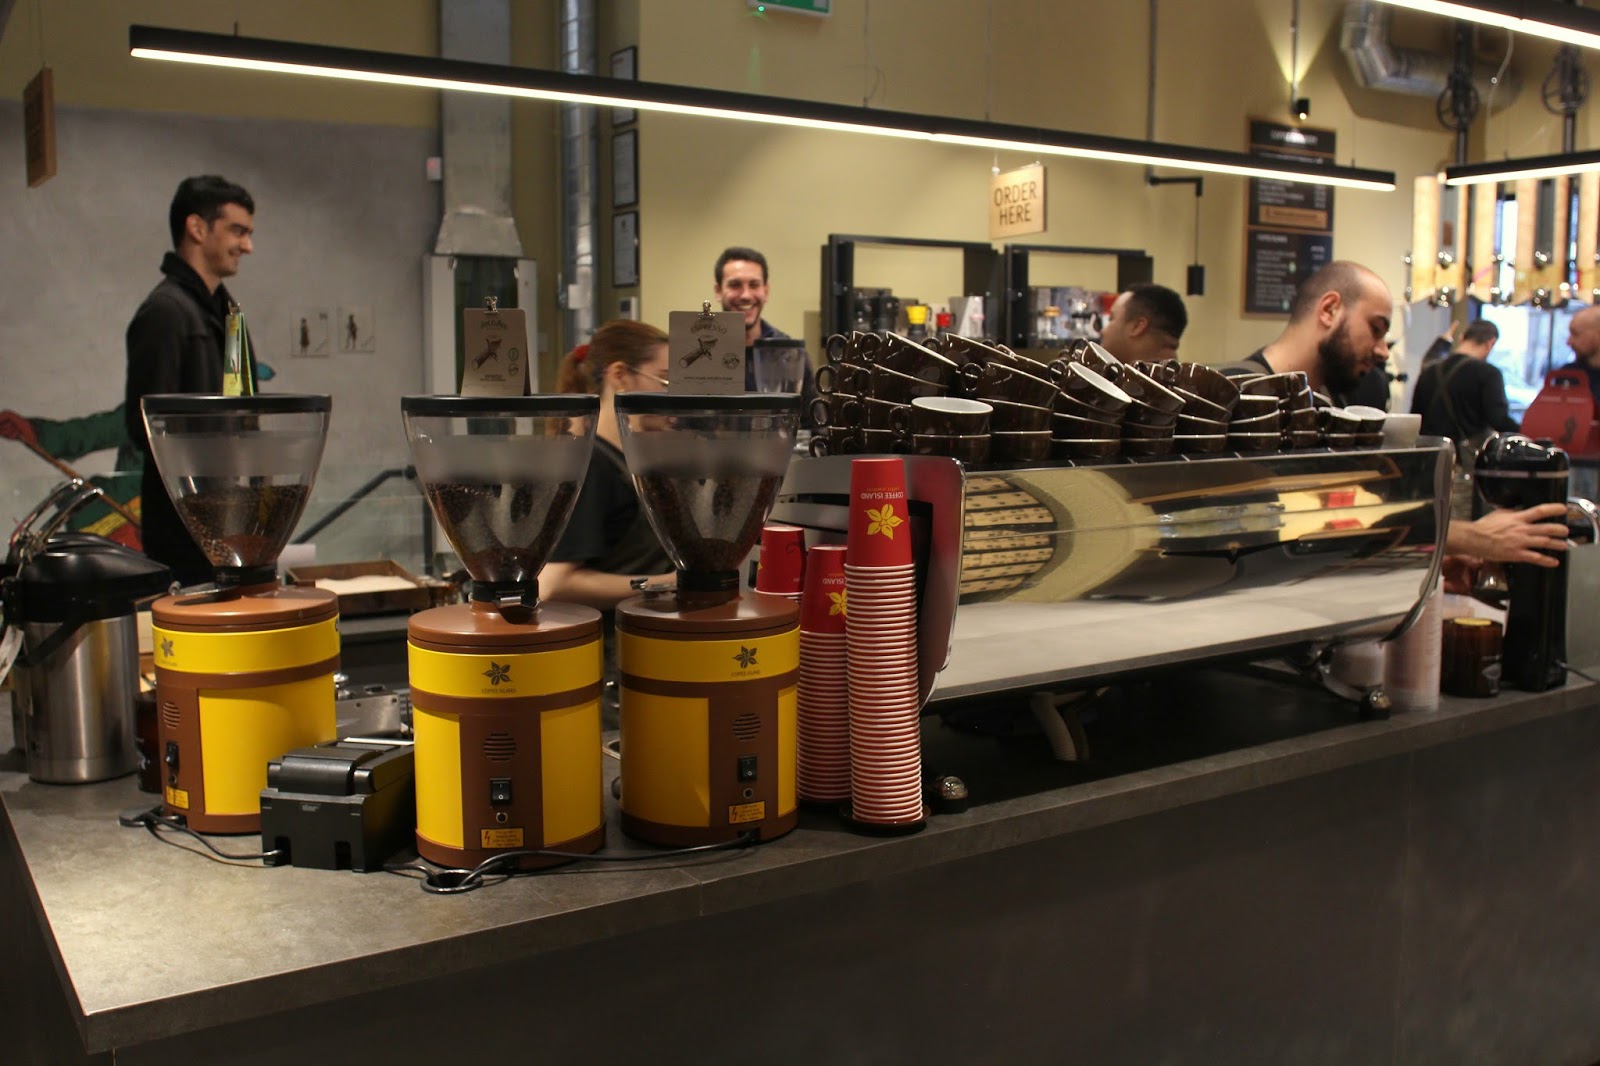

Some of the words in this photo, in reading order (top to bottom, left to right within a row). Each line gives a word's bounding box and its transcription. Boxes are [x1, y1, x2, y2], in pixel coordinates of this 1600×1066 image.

[993, 181, 1037, 207] ORDER
[999, 202, 1031, 226] HERE
[690, 323, 728, 335] ESPRESSO
[860, 492, 884, 500] ISLAND
[885, 491, 904, 500] COFFEE
